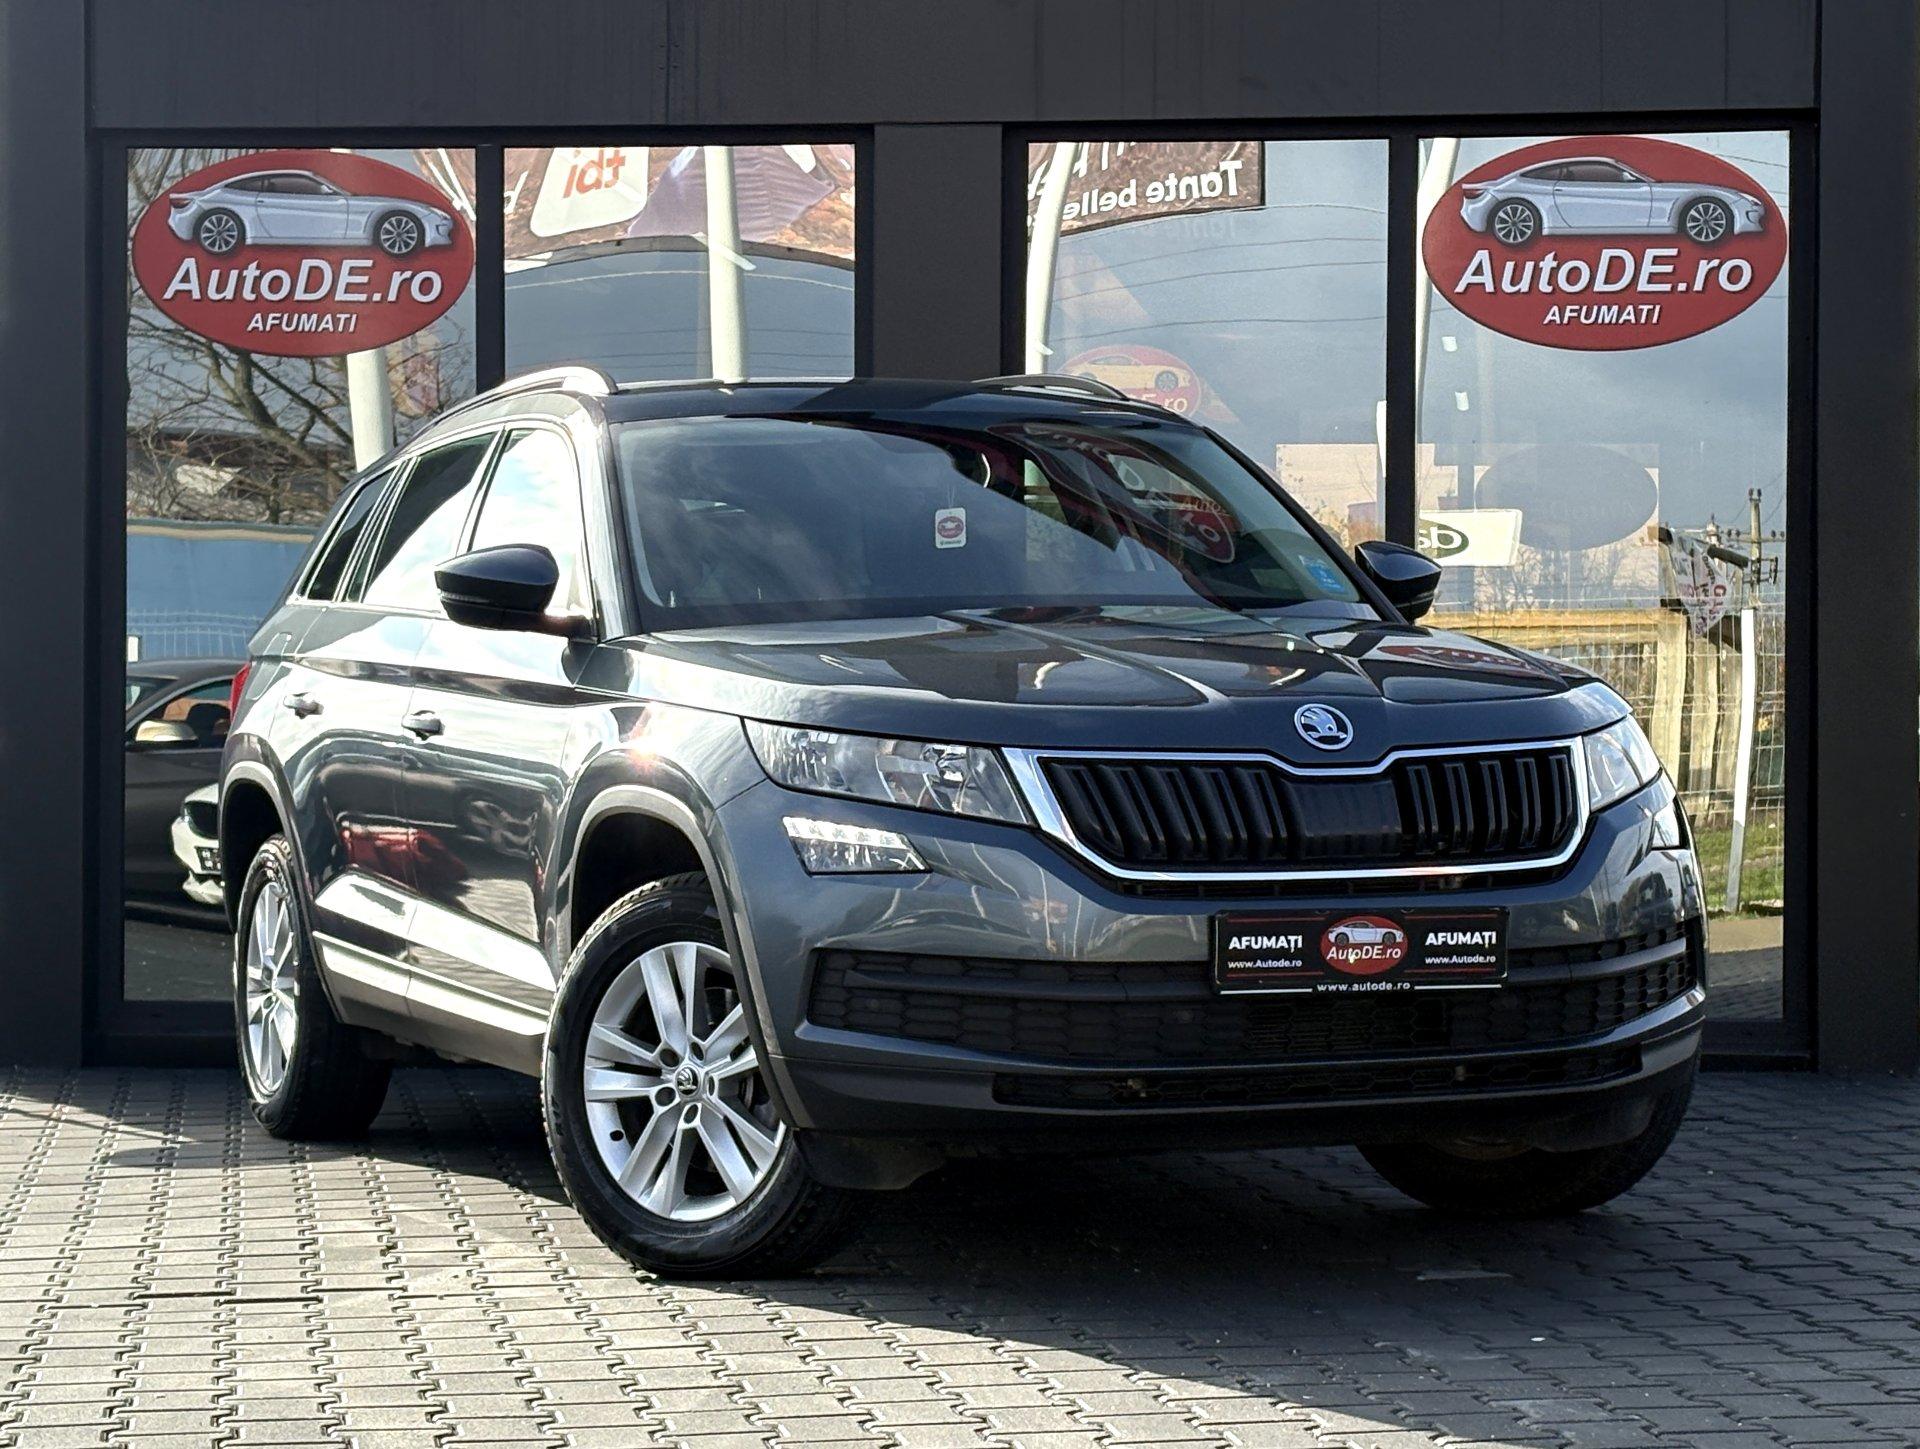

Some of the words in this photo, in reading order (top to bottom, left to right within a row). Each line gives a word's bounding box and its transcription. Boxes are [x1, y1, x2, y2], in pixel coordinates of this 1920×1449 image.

[162, 257, 443, 303] AutoDE.ro
[1454, 247, 1753, 294] AutoDE.ro
[247, 312, 358, 333] AFUMATI
[1543, 304, 1661, 326] AFUMATI
[1326, 945, 1402, 962] AutoDE.ro
[1425, 954, 1497, 965] www.Autode.ro
[1227, 958, 1303, 969] www.Autode.ro
[1316, 981, 1411, 992] www.autode.ro
